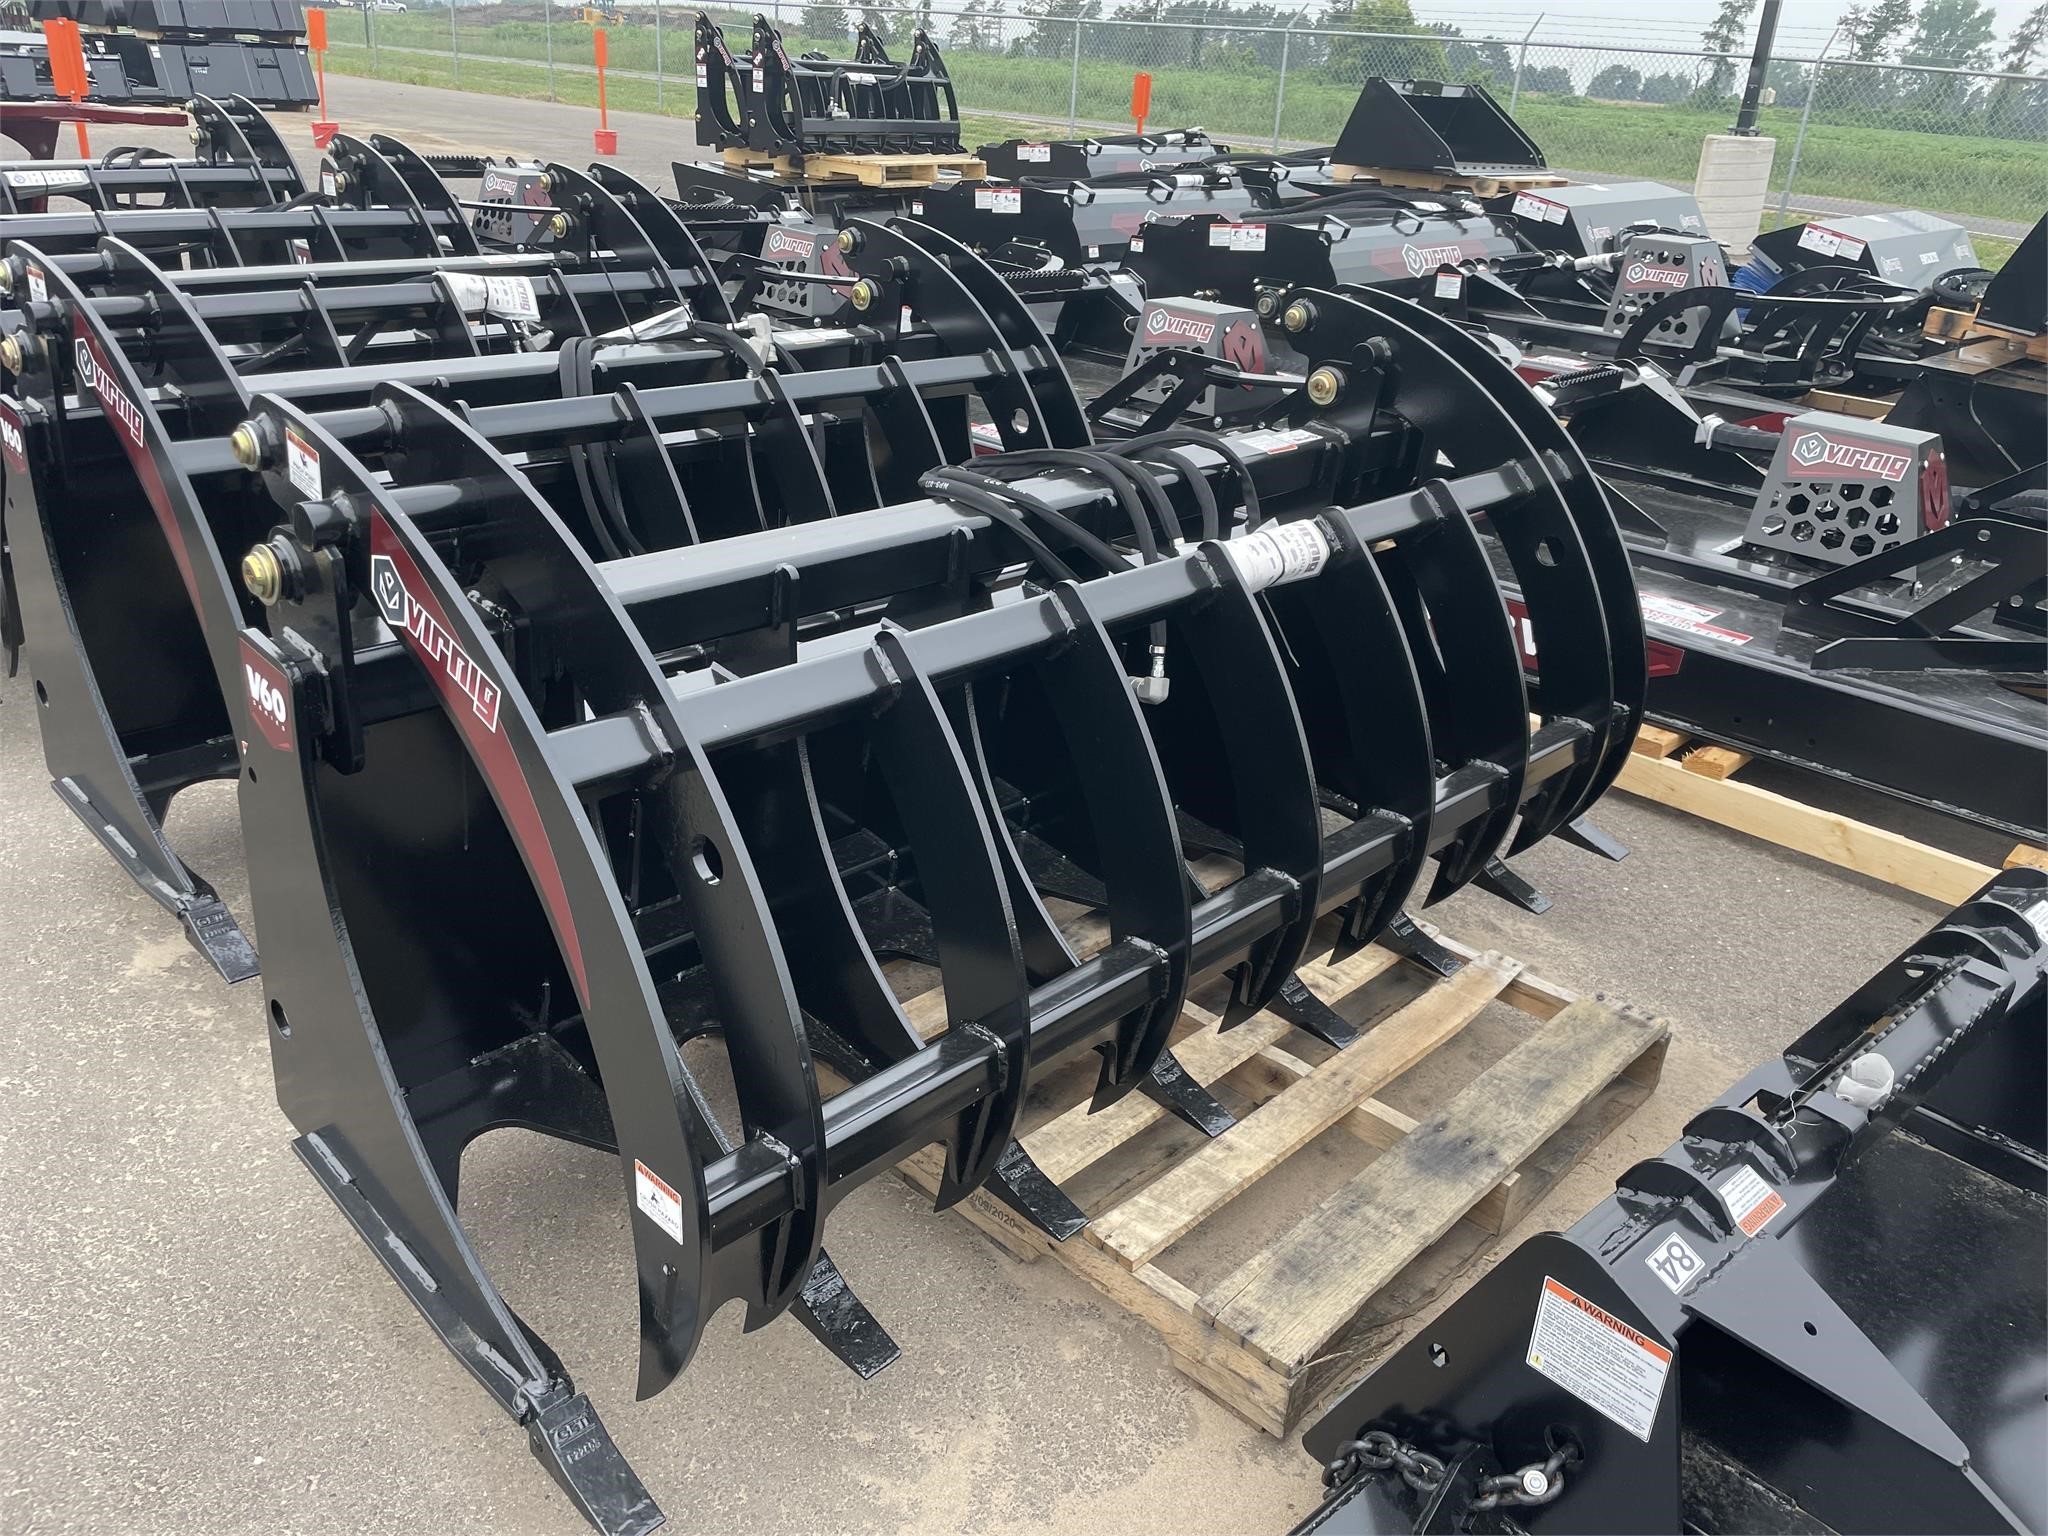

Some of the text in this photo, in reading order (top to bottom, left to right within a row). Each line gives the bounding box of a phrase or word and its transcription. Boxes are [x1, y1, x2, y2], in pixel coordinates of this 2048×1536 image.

[246, 664, 286, 723] V60
[1743, 1200, 1775, 1231] WARNING
[1653, 1242, 1695, 1285] 84
[1583, 1303, 1645, 1347] WARNING
